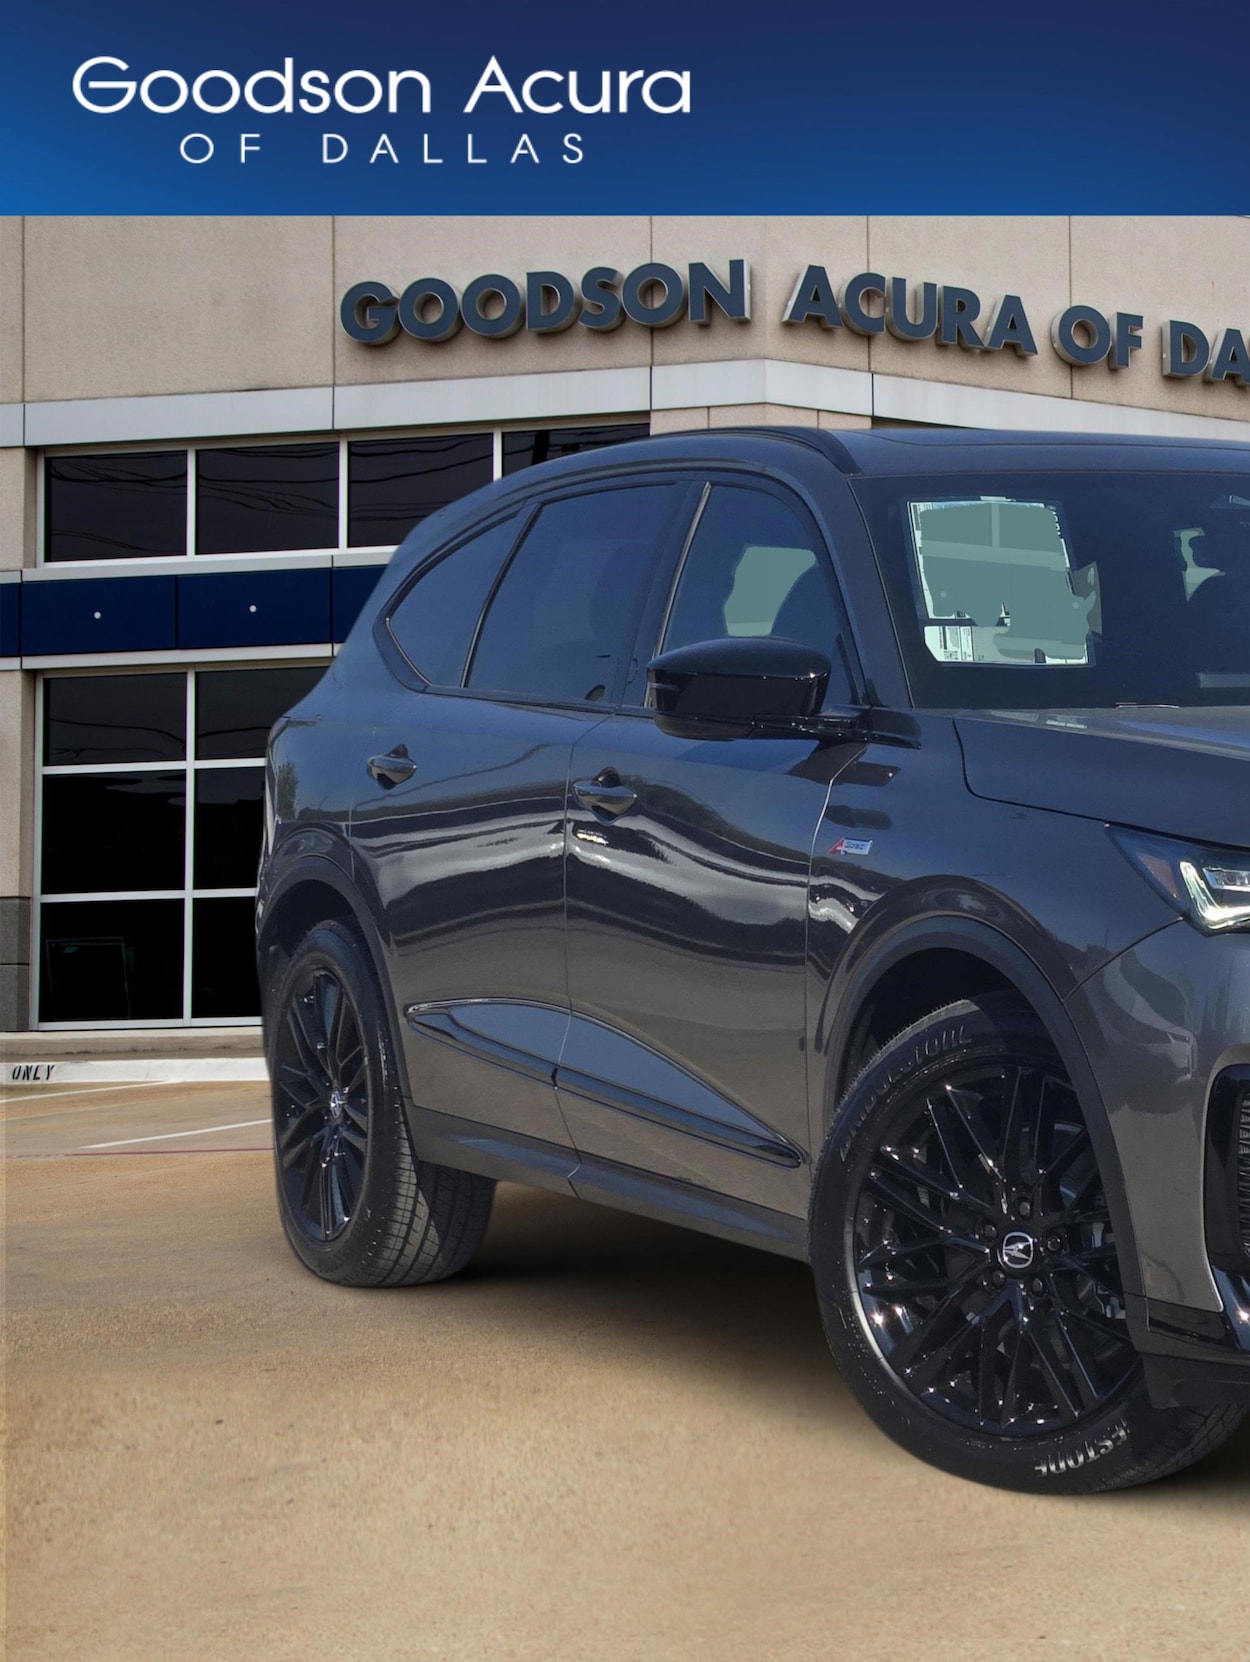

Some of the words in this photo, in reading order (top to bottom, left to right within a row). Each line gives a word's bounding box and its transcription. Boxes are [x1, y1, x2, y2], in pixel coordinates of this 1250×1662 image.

[340, 258, 751, 348] GOODSON
[783, 264, 1038, 357] ACURA
[1051, 303, 1143, 370] OF
[12, 1064, 55, 1081] ONLY
